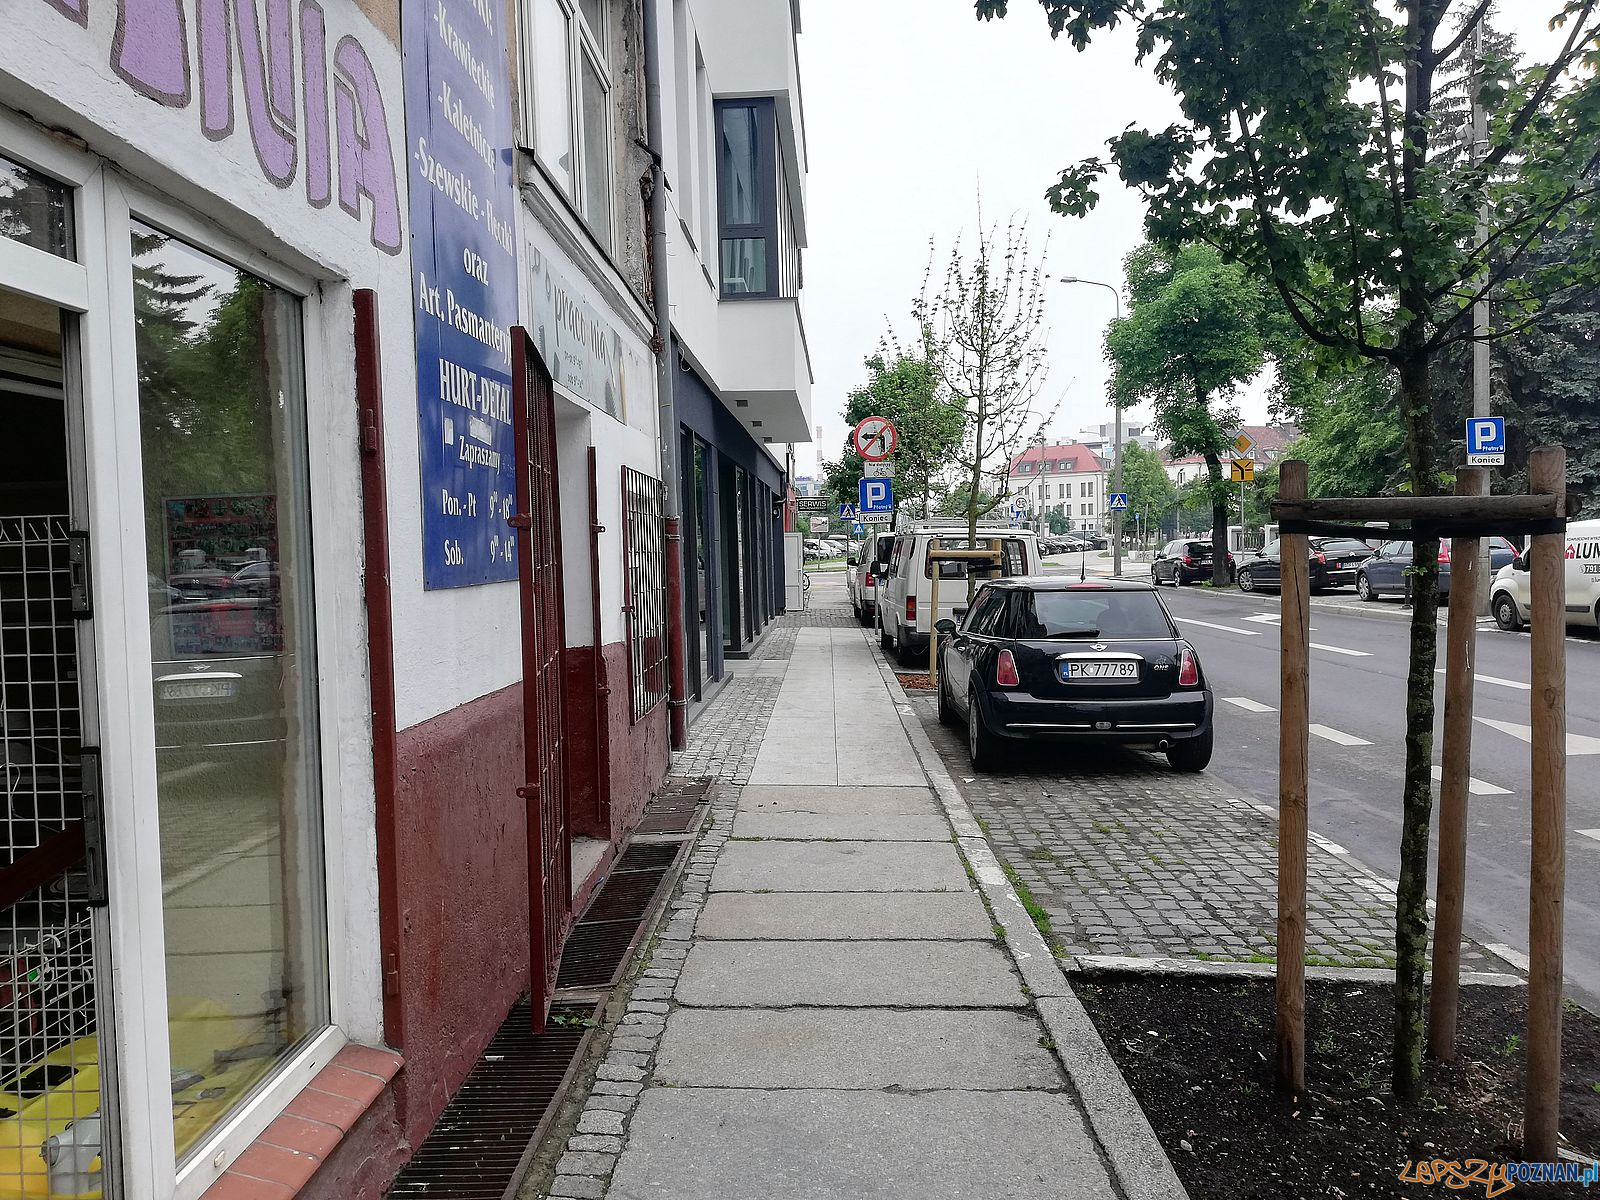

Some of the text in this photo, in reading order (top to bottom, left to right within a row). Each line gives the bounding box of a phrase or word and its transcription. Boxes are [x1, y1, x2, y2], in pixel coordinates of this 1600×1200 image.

[463, 248, 489, 286] oraz
[419, 271, 445, 322] Art.
[1475, 421, 1496, 450] P
[459, 435, 501, 476] Zapraszamy
[1471, 456, 1501, 464] Koniec
[798, 500, 827, 508] SERWIS
[866, 482, 886, 509] P
[444, 539, 464, 566] Sob.
